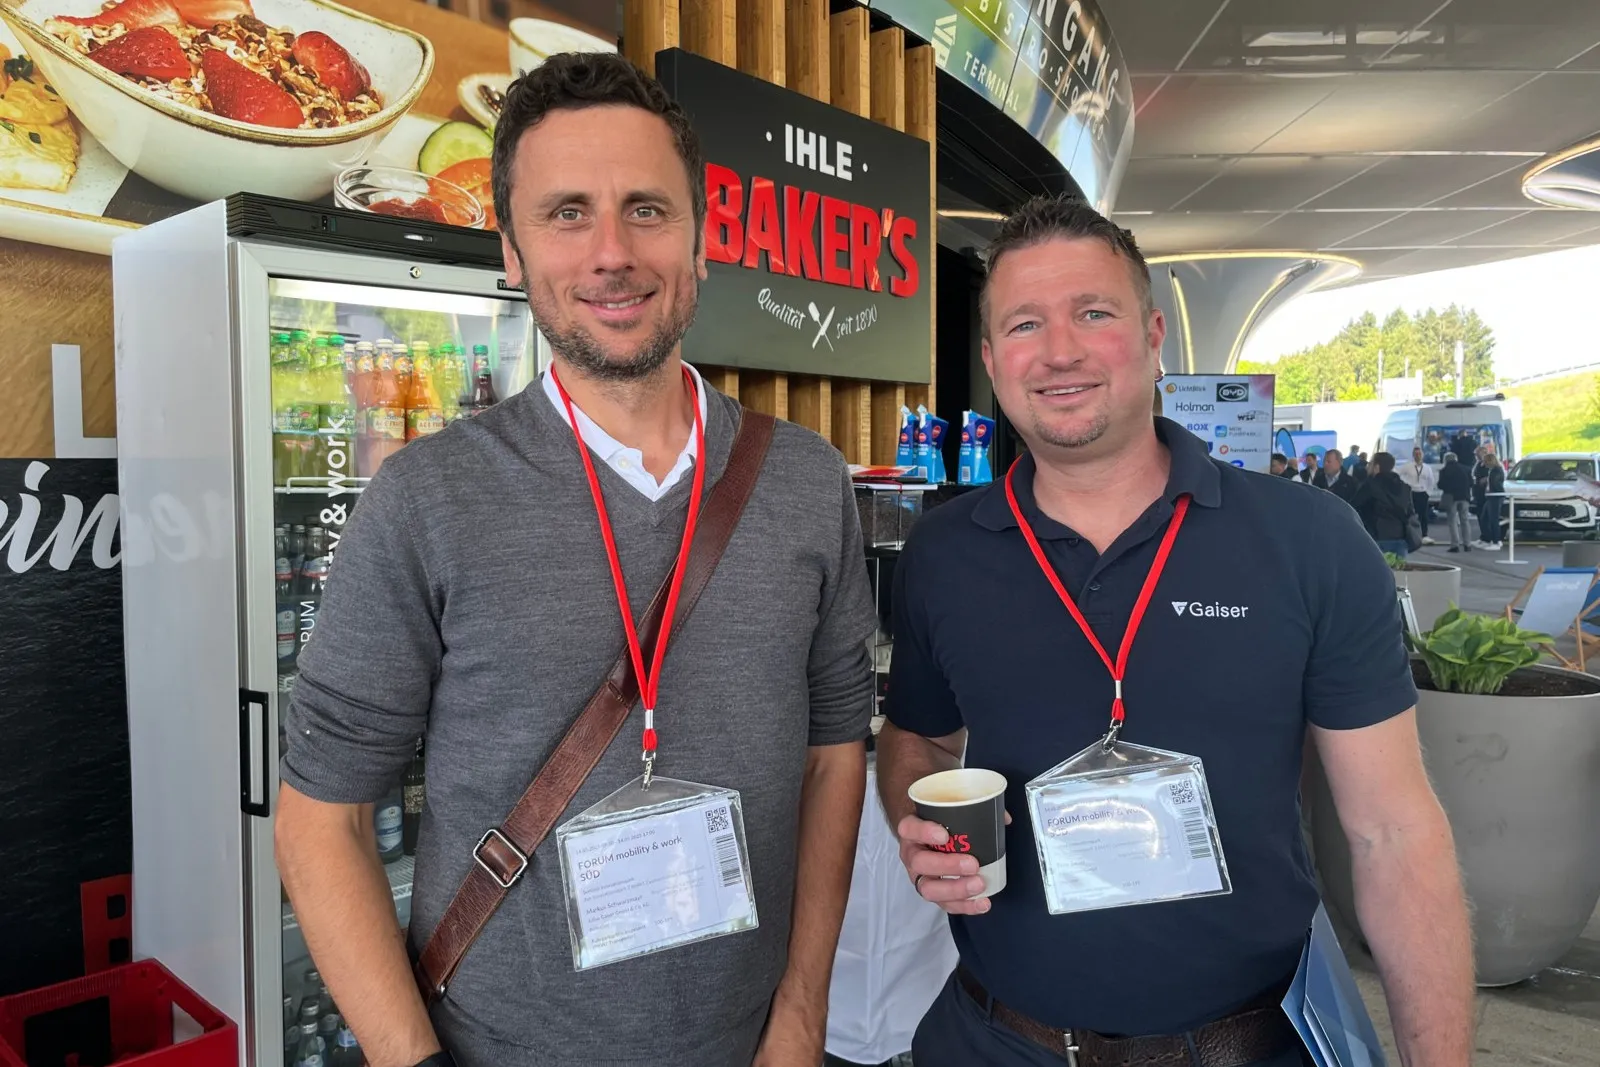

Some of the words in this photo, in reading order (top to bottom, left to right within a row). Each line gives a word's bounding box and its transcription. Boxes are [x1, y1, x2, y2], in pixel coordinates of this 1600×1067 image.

[963, 51, 1020, 112] TERMINAL
[785, 123, 853, 181] IHLE
[705, 162, 919, 298] BAKER'S
[758, 288, 806, 330] Qualität
[836, 316, 854, 339] seit
[1222, 388, 1245, 396] BYD
[1175, 402, 1215, 412] Holman
[319, 416, 347, 498] work
[320, 503, 347, 525] &
[1189, 601, 1249, 618] Gaiser
[300, 600, 315, 652] RUM
[1047, 814, 1081, 827] FORUM
[1082, 809, 1115, 822] mobility
[578, 854, 614, 870] FORUM
[616, 846, 650, 861] mobility
[652, 841, 659, 850] &
[660, 835, 682, 848] work
[580, 869, 601, 882] SÜD
